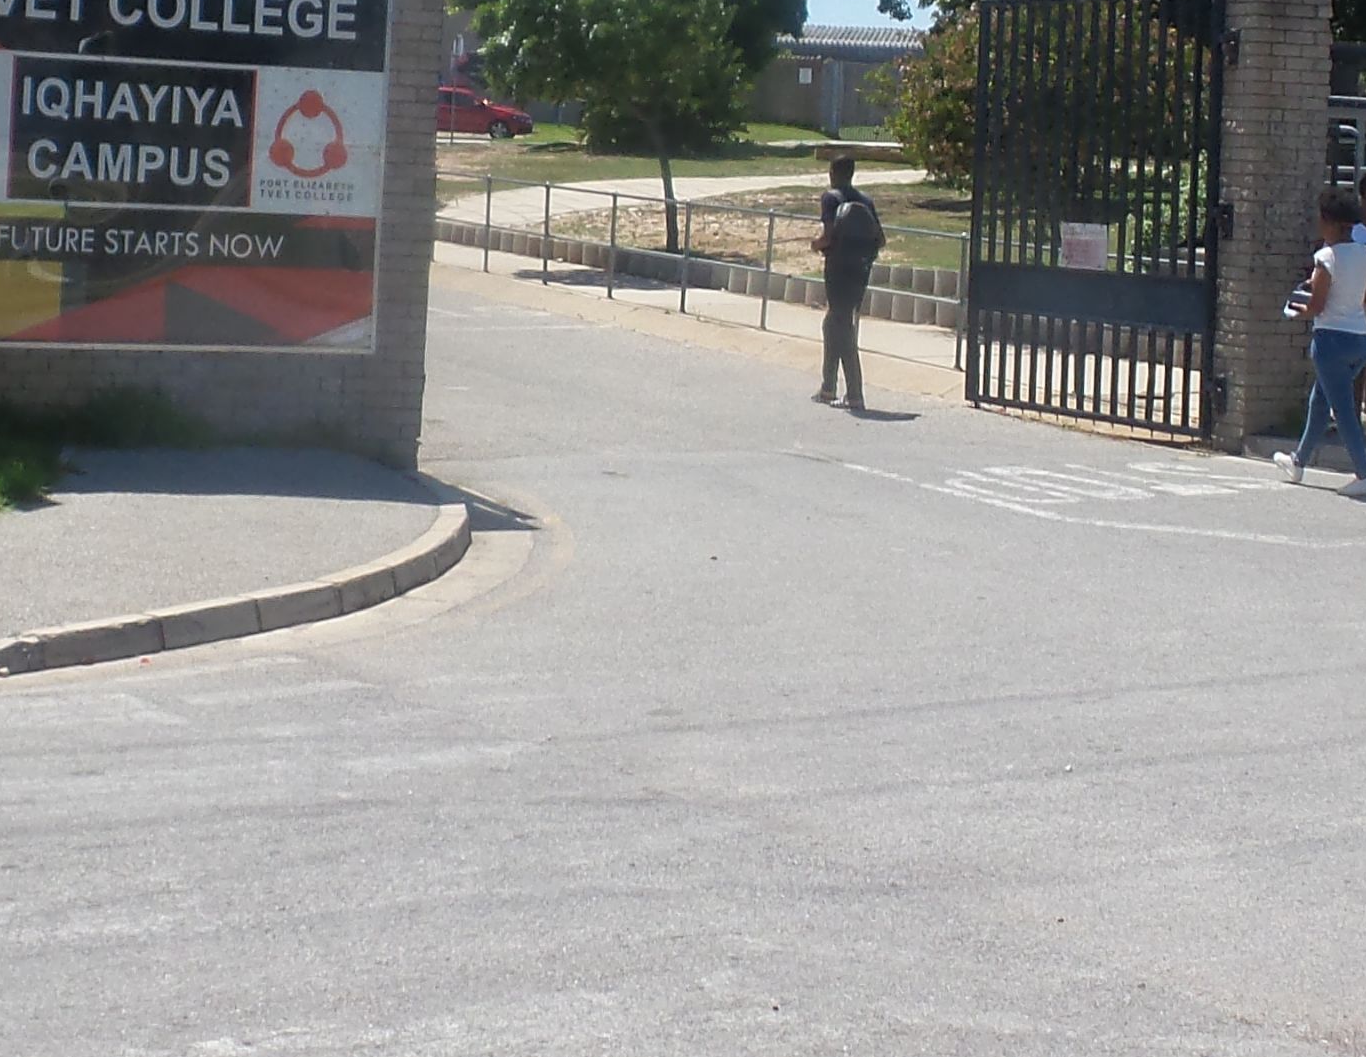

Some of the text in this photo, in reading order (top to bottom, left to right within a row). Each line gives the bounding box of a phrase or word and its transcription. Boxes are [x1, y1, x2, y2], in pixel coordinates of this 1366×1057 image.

[21, 75, 244, 128] IQHAYIYA
[26, 138, 231, 188] CAMPUS
[260, 188, 354, 202] TVET COLLEGE
[103, 228, 200, 257] STARTS
[208, 232, 285, 259] NOW
